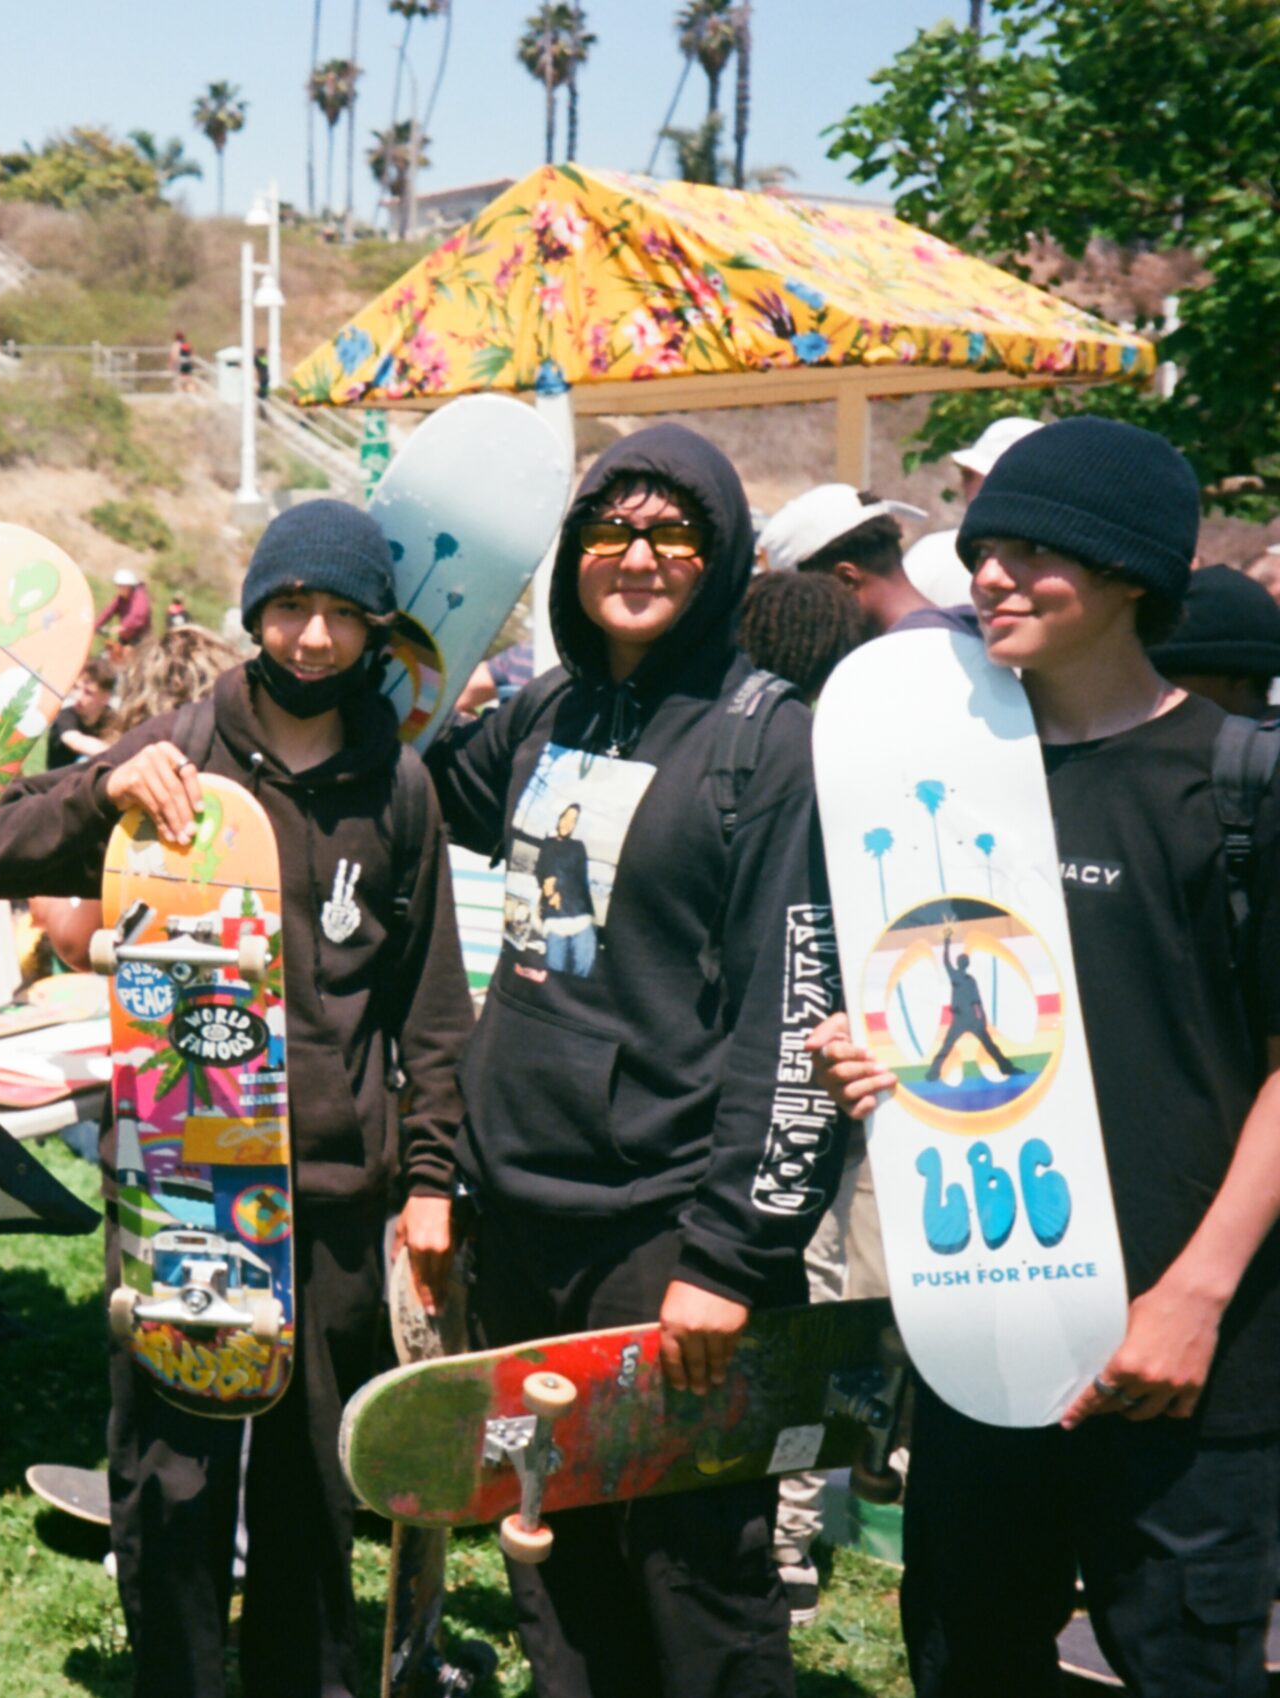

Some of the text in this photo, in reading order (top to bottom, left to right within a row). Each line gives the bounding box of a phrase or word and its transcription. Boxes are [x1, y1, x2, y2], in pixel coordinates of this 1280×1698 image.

[1059, 862, 1121, 885] ACY
[122, 962, 164, 981] PUSH
[120, 986, 176, 1015] PEACE
[184, 1007, 251, 1030] WORLD
[178, 1031, 255, 1061] FAMOUS
[912, 1262, 1098, 1287] PUSH FOR PEACE
